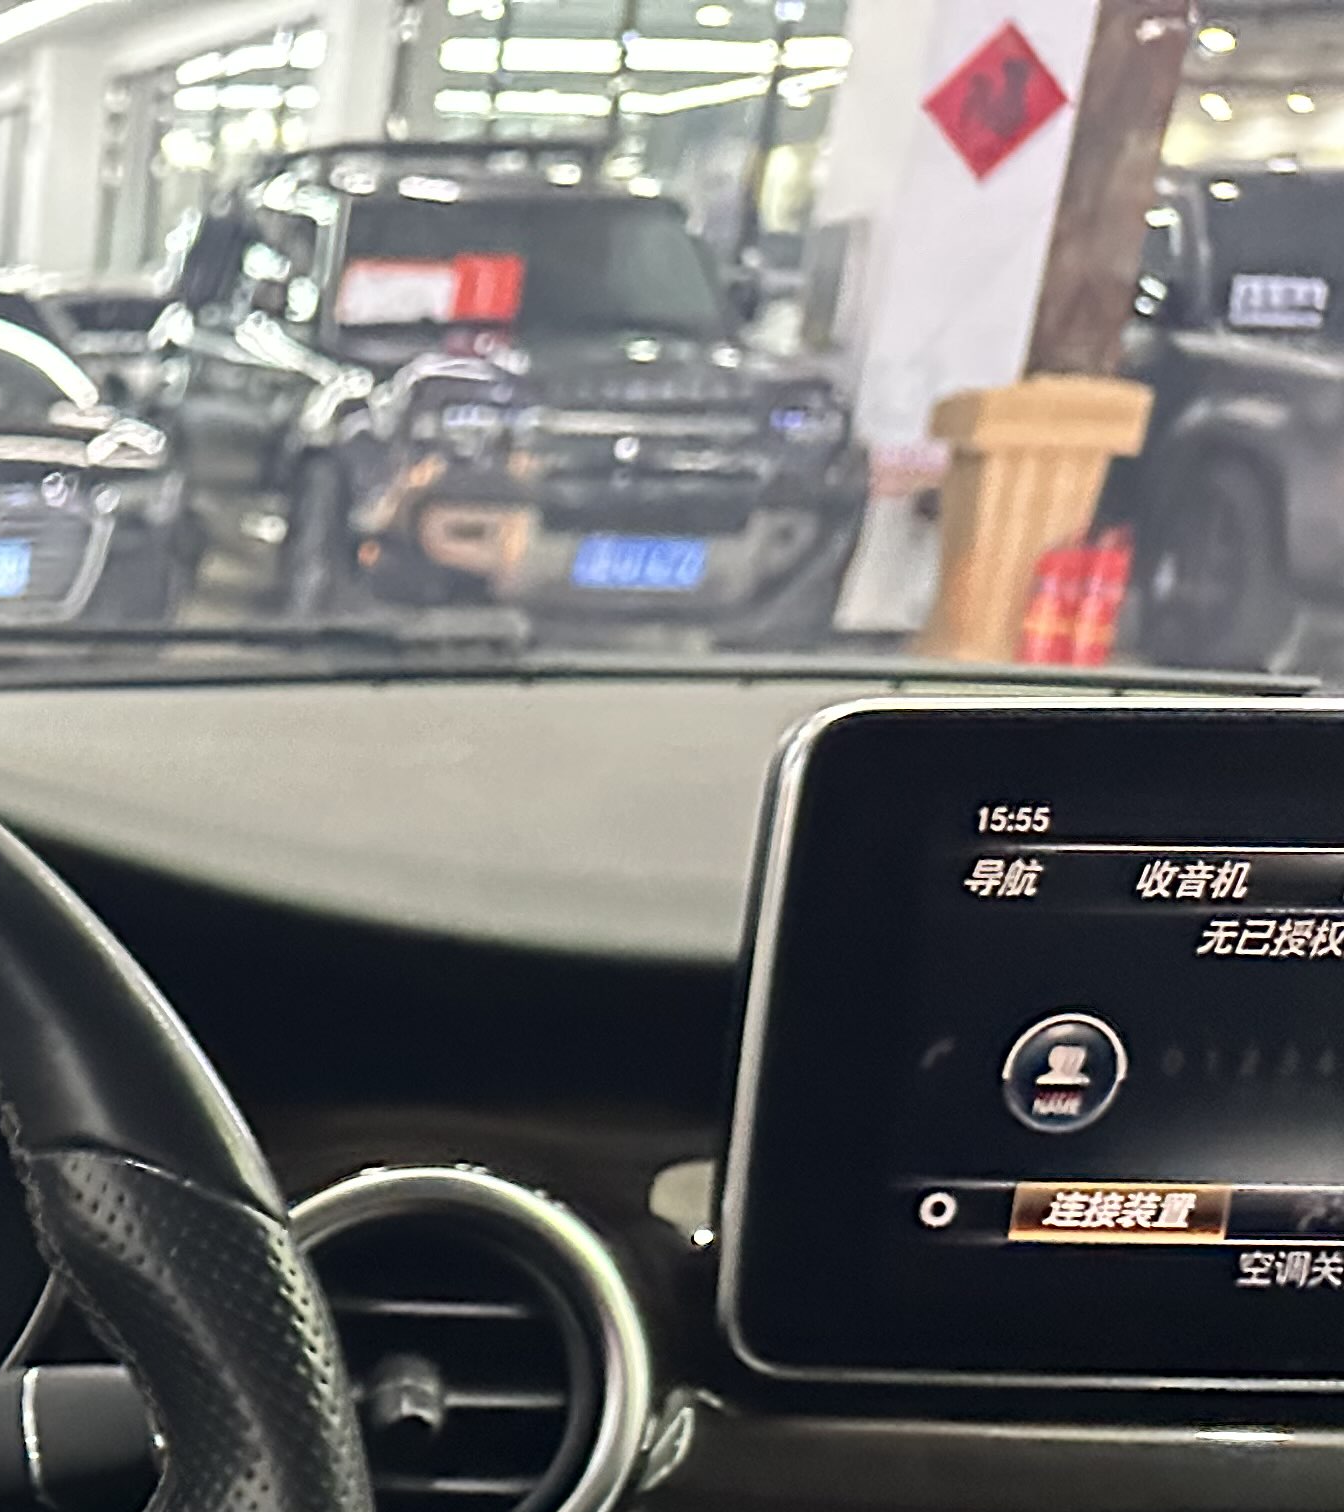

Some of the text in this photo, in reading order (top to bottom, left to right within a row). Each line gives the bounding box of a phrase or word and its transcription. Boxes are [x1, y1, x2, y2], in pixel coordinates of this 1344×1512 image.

[977, 806, 1052, 833] 15:55
[964, 858, 1252, 900] 导航 收音机
[1196, 918, 1344, 958] 无已授权
[1043, 1191, 1197, 1230] 连接装置
[1236, 1250, 1344, 1289] 空调关
